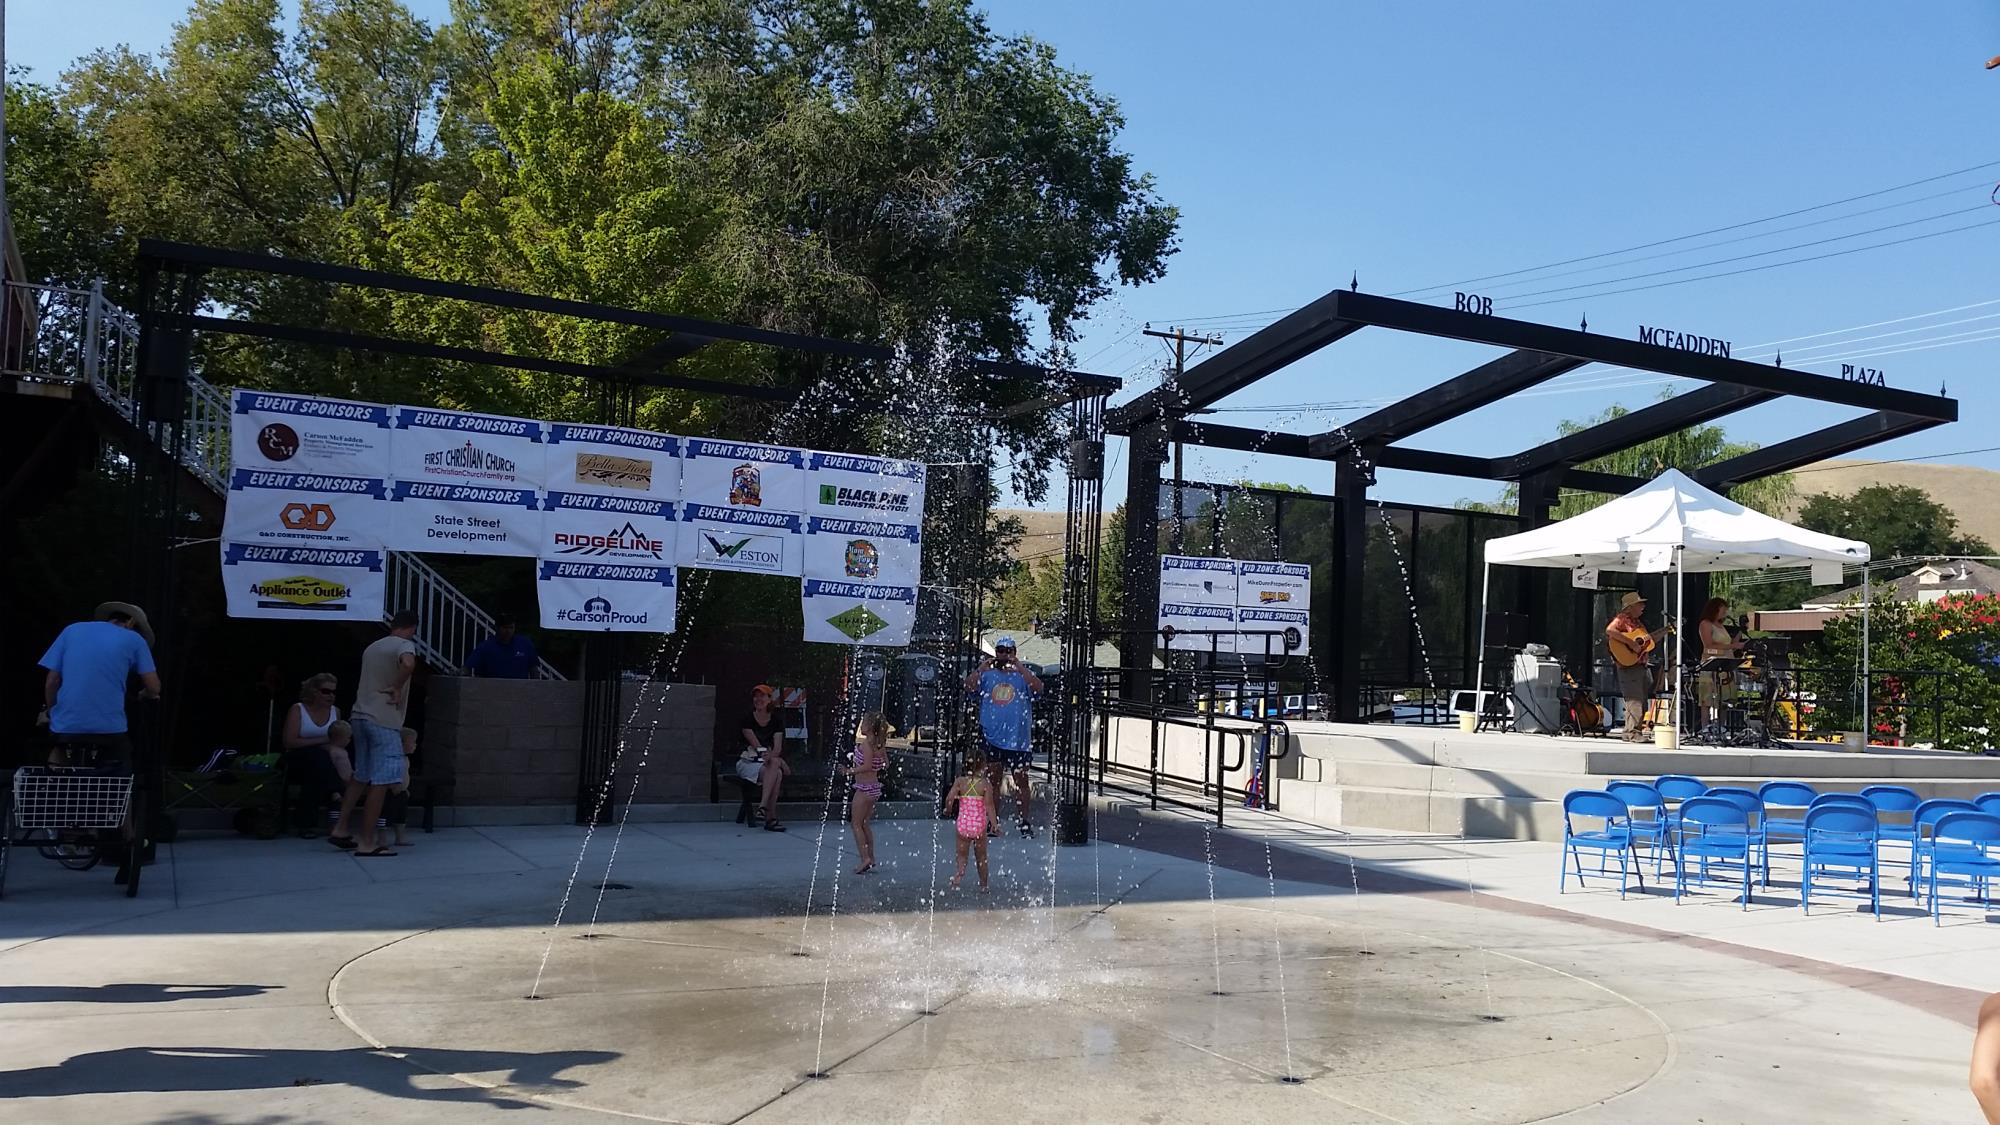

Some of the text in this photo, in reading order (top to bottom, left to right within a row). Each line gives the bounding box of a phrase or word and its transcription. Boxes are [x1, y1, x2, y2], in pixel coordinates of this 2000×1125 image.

[1455, 292, 1886, 387] BOB MCFADDEN PLAZA
[255, 396, 373, 420] EVENT SPONSORS
[415, 412, 527, 434] EVENT SPONSORS
[565, 427, 666, 449] EVENT SPONSORS
[425, 447, 515, 472] FIRST CHRISTIAN CHURCH
[700, 442, 791, 462] EVENT SPONSORS
[823, 456, 908, 475] EVENT SPONSS
[250, 472, 369, 491] EVENT SPONSORS
[410, 484, 521, 503] EVENT SPONSORS
[837, 488, 909, 505] BLACK PINE
[561, 494, 661, 514] EVENT SPONSORS
[837, 500, 909, 512] CONSTRUCTION
[434, 515, 500, 528] State Street
[698, 506, 789, 526] EVENT SPONSORS
[427, 528, 507, 542] Development
[820, 520, 907, 537] EVENT SPONSORS
[554, 533, 663, 552] RIDGELINE
[244, 546, 364, 564] EVENT SPONSORS
[609, 551, 653, 559] DEVELOPMENT
[557, 563, 658, 580] EVENT SPONSORS
[1167, 559, 1233, 570] KID ZONE SPONSORS
[1243, 563, 1307, 575] KID ZONE SPONSORS
[250, 584, 351, 598] Appliance Outlet
[819, 582, 904, 599] EVENT SPONSORS
[557, 608, 647, 624] #CarsonProud
[1165, 605, 1231, 617] KID ZONE SPONSORS
[1241, 610, 1305, 621] KID ZONE SPONSORS
